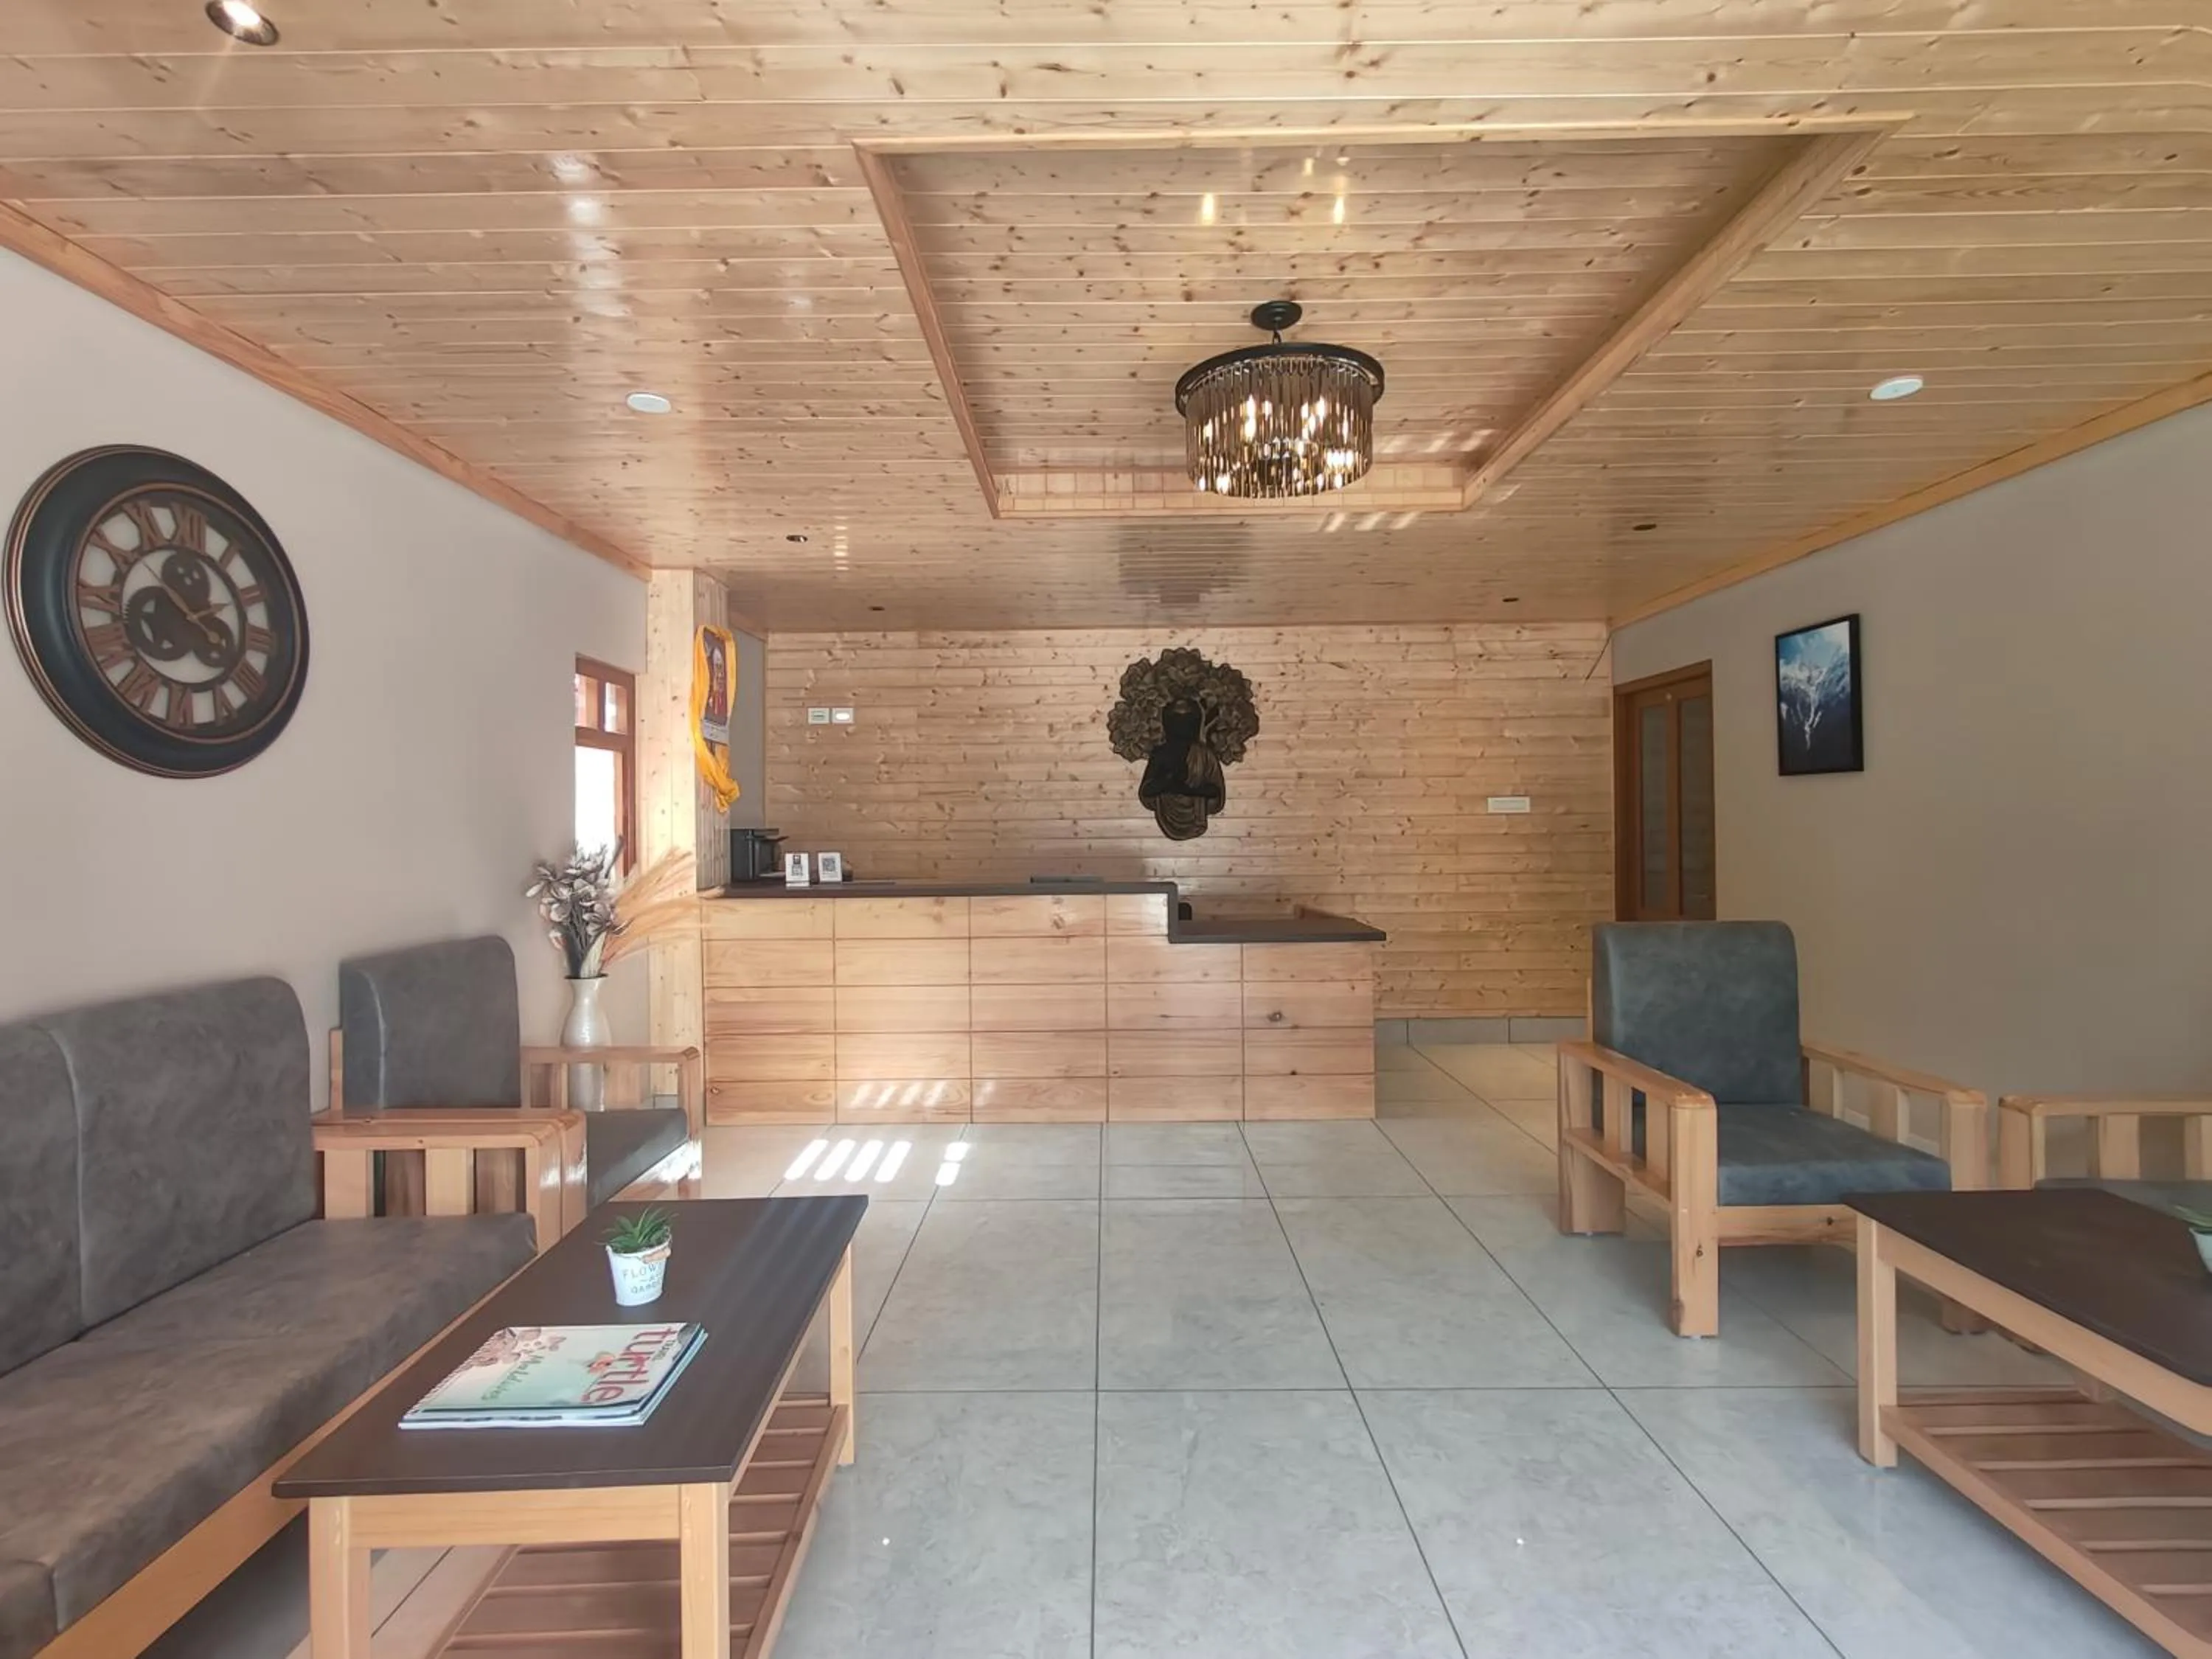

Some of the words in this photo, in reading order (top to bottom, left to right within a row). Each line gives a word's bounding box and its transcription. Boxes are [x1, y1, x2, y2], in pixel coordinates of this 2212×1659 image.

[621, 1262, 660, 1279] FLOW
[480, 1354, 544, 1400] Maldives
[580, 1326, 678, 1404] turtle
